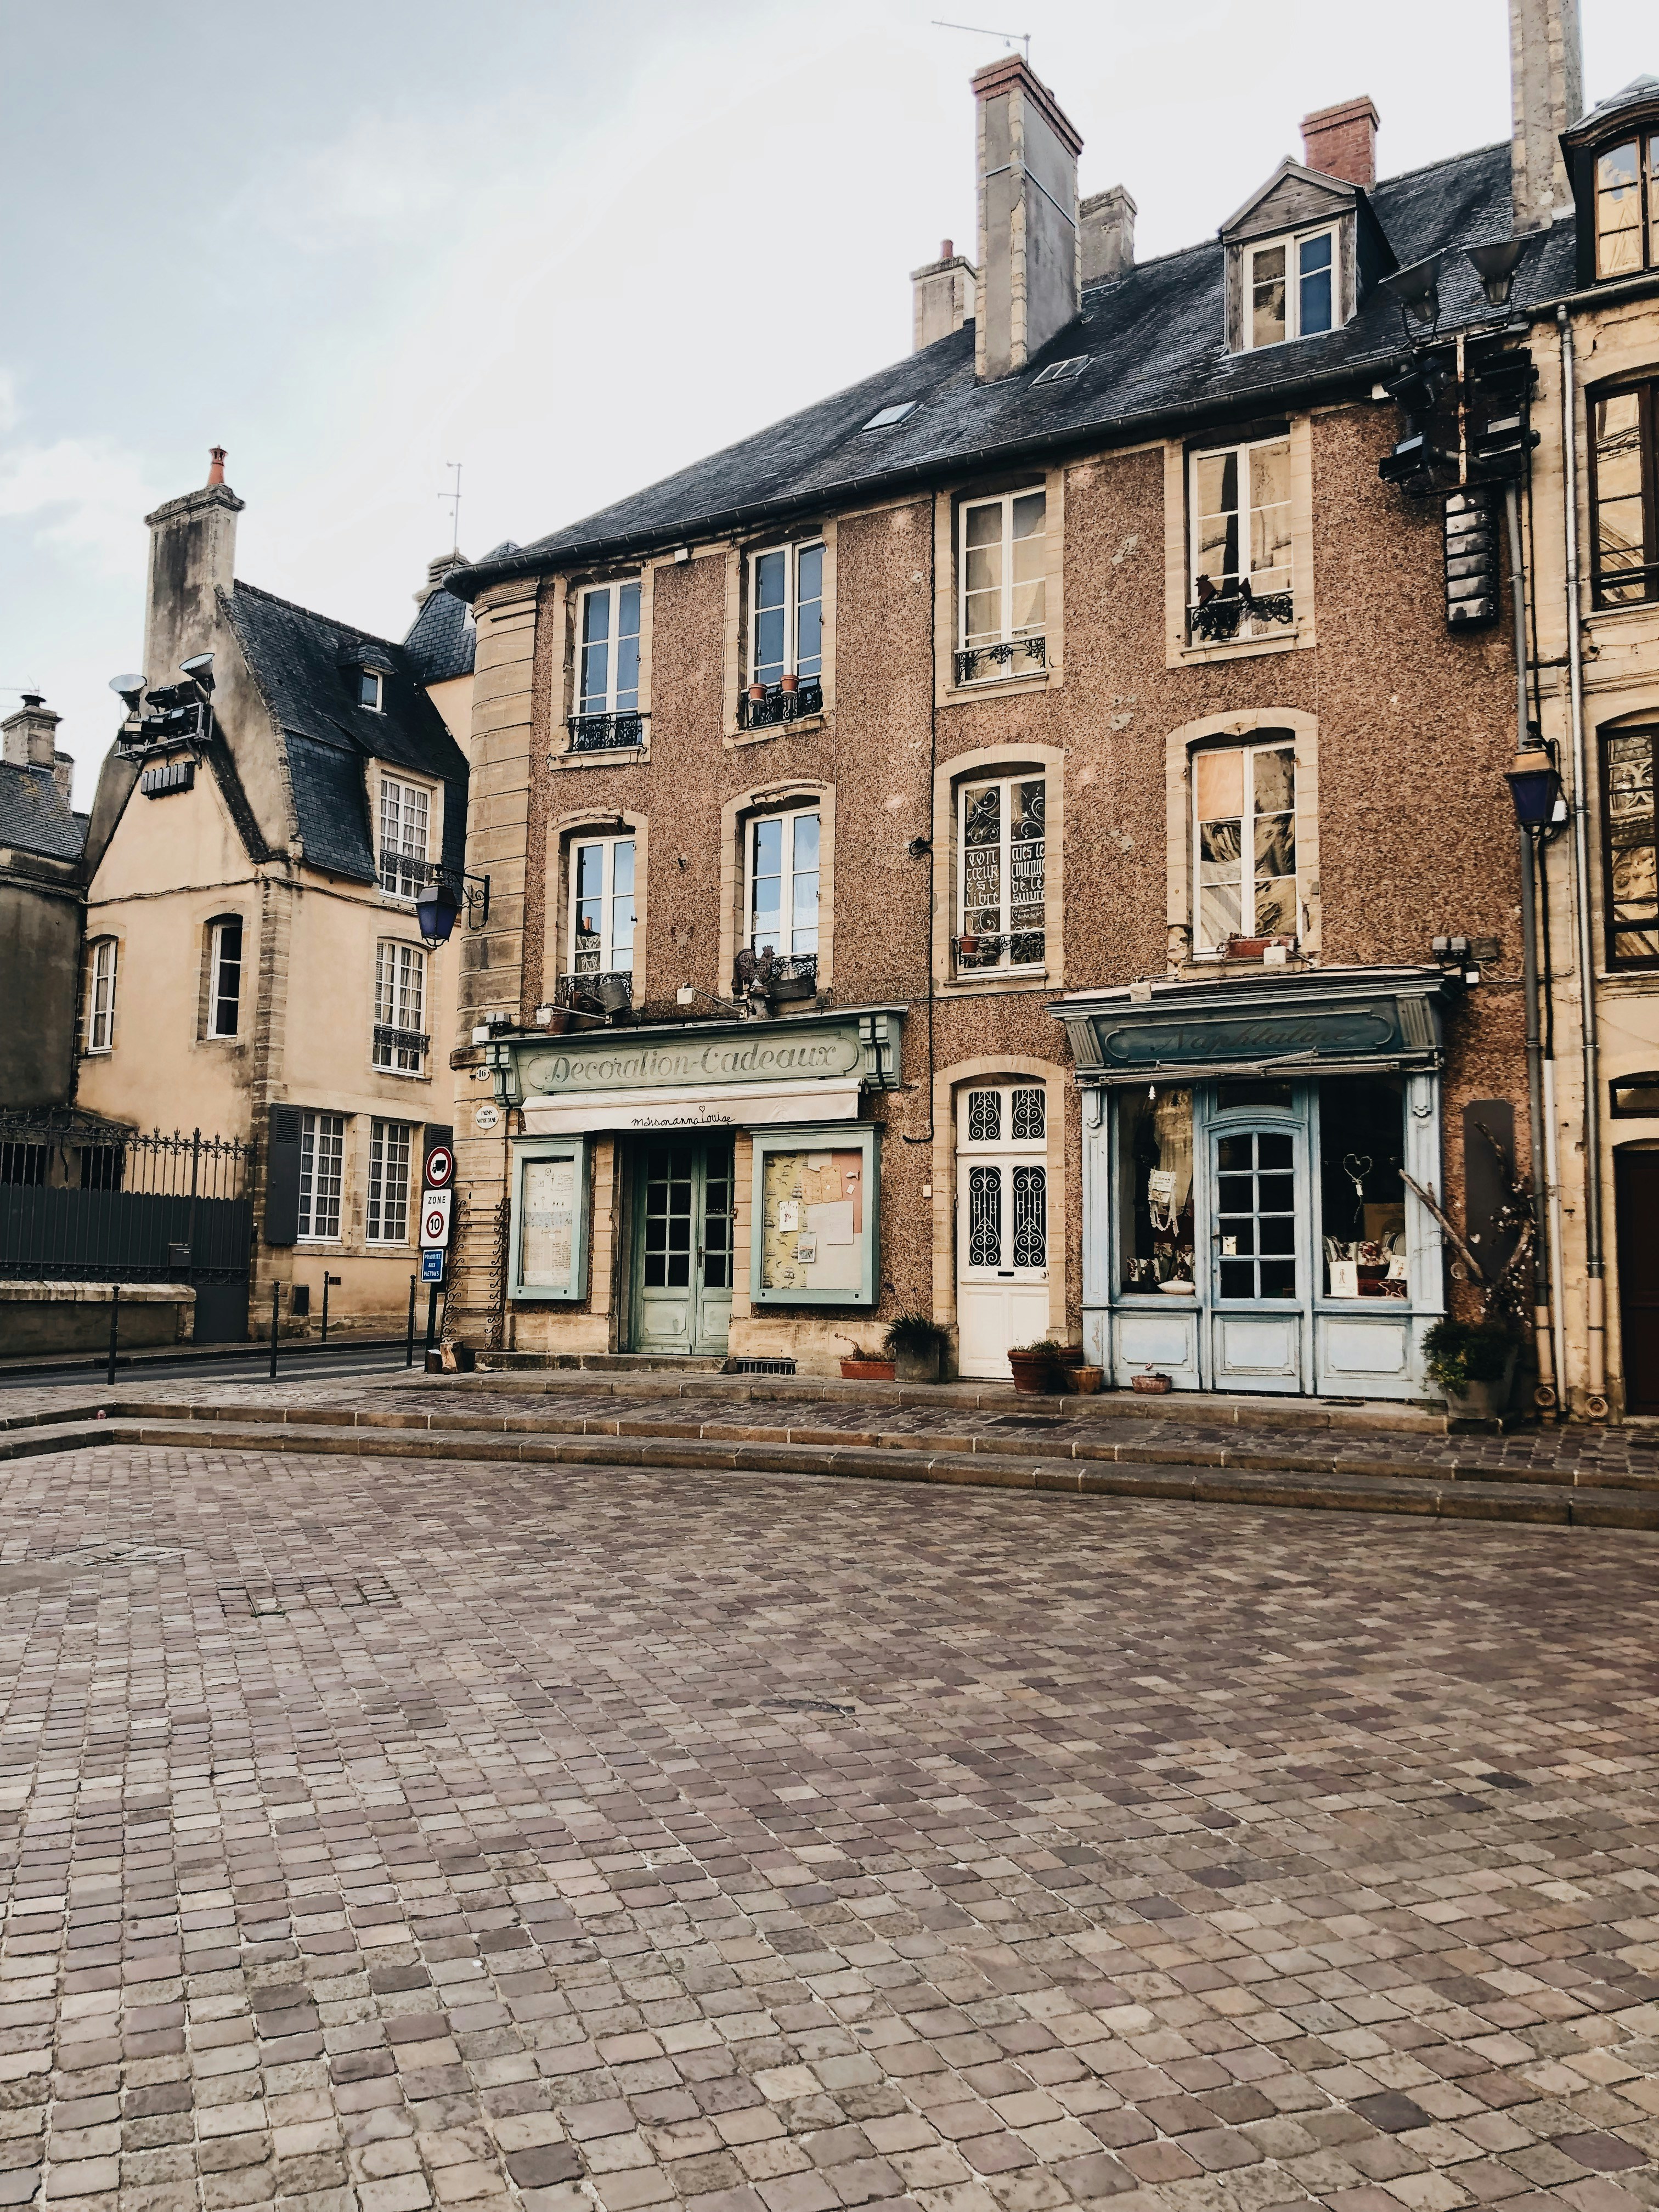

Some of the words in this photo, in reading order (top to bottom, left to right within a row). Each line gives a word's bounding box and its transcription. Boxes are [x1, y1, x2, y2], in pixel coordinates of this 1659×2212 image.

[479, 1069, 486, 1077] 16
[428, 1195, 446, 1204] ZONE
[430, 1218, 439, 1231] 10
